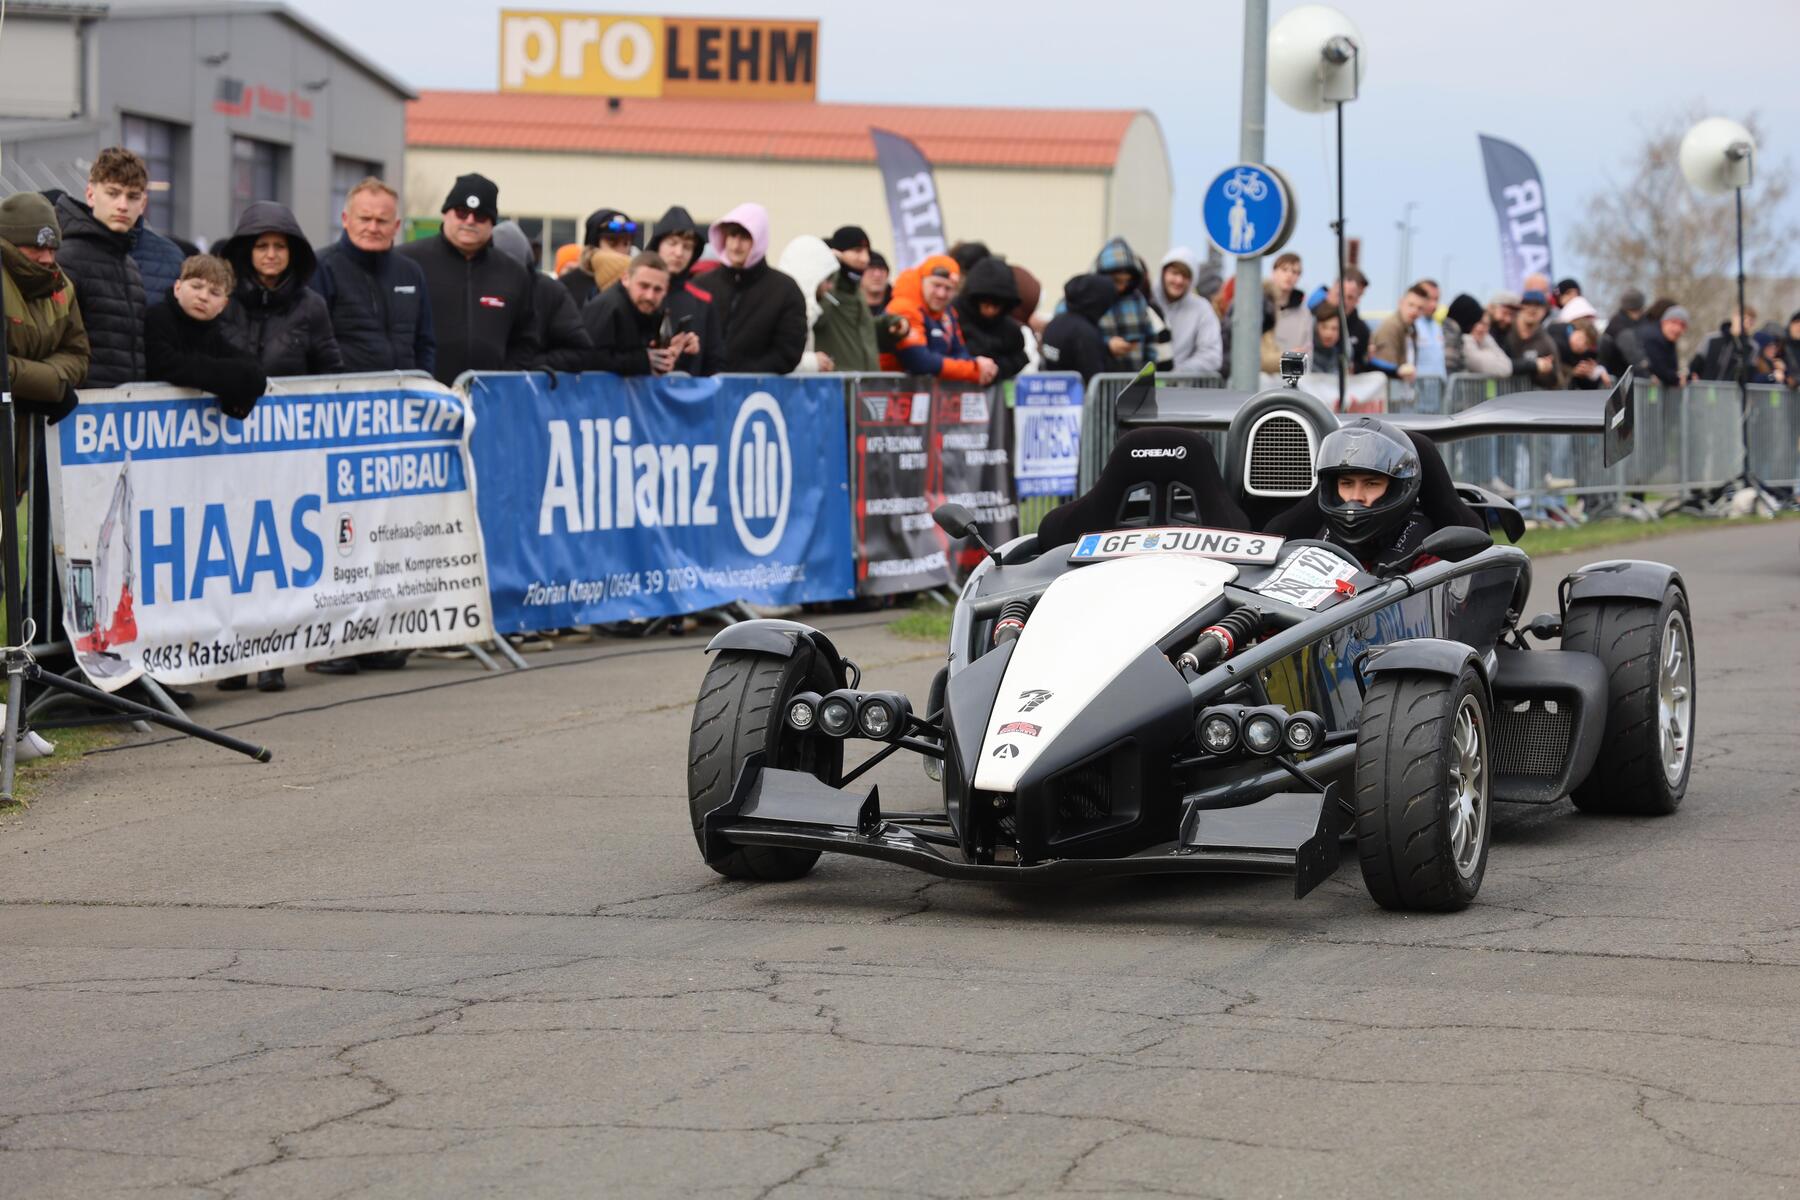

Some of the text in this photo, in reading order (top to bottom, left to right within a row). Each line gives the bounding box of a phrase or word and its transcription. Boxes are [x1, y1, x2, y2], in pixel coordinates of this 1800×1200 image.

[503, 16, 814, 87] pro LEHM
[75, 397, 464, 455] BAUMASCHINENVERLEIH
[1131, 448, 1176, 458] CORBEAU
[336, 452, 449, 497] & ERDBAU
[538, 416, 719, 536] Allianz
[140, 494, 324, 606] HAAS
[404, 552, 479, 574] Kompressor
[1102, 534, 1141, 553] GF
[1162, 532, 1240, 554] JUNG
[1246, 539, 1266, 556] 3
[523, 580, 567, 606] Florian
[567, 578, 604, 605] Knapp
[643, 569, 665, 595] 39
[142, 643, 183, 674] 8483
